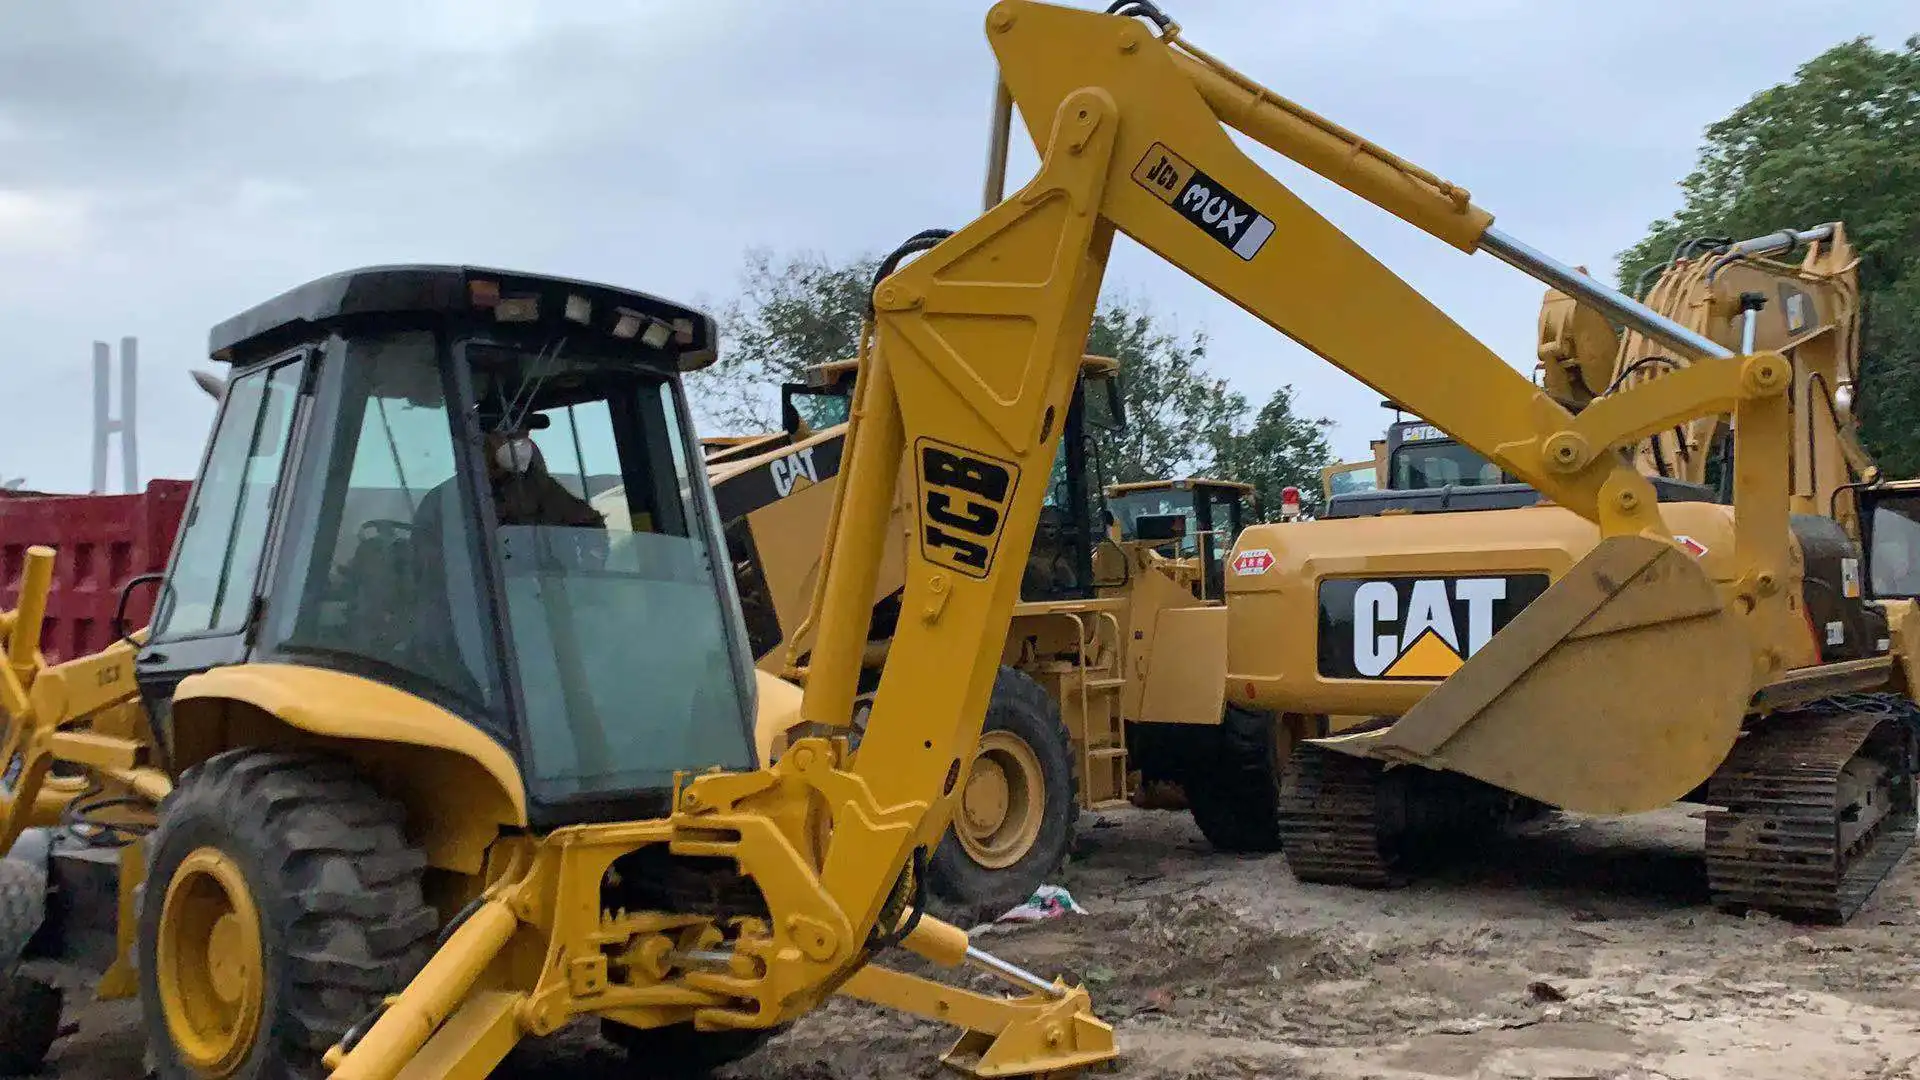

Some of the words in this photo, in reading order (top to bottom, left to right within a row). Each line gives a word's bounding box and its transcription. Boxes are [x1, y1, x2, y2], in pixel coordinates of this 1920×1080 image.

[1146, 155, 1179, 191] JCB
[770, 446, 818, 497] CAT
[923, 447, 1010, 569] JCB
[1353, 578, 1506, 677] CAT
